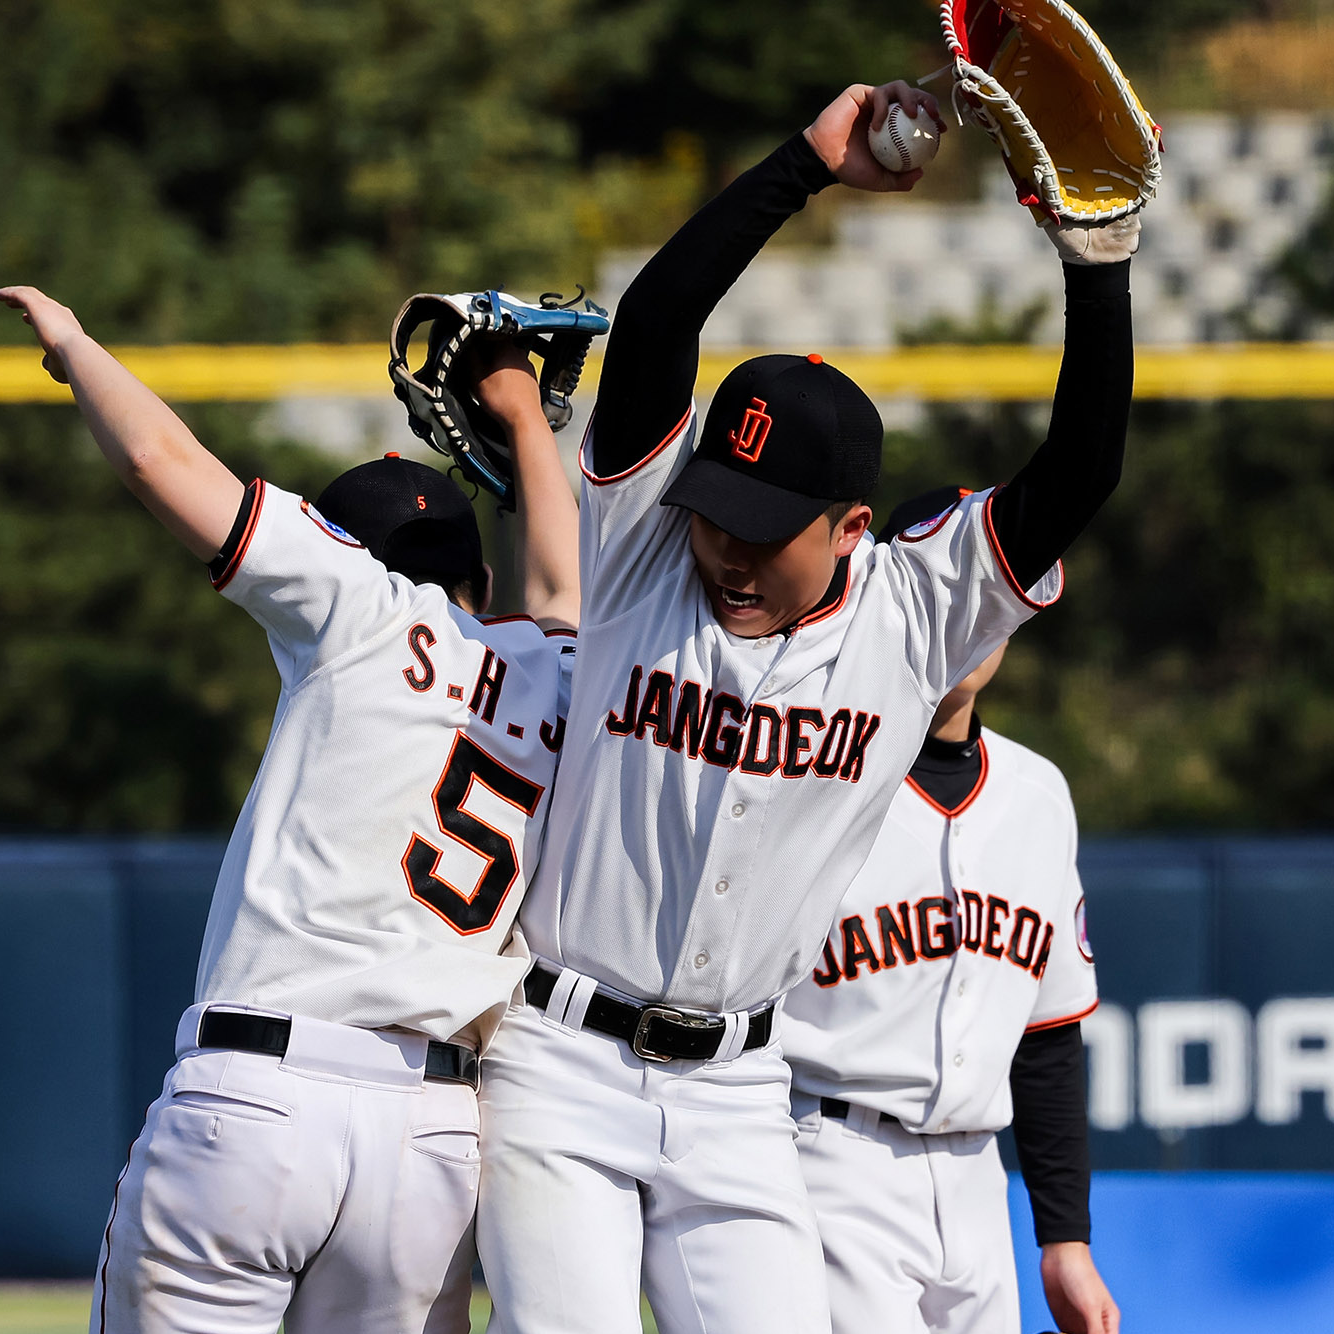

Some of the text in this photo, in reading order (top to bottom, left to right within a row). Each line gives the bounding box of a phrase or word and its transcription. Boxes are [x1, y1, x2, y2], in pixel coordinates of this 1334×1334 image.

[417, 495, 427, 510] 5
[605, 664, 881, 783] JANGDEOK
[401, 729, 546, 937] 5
